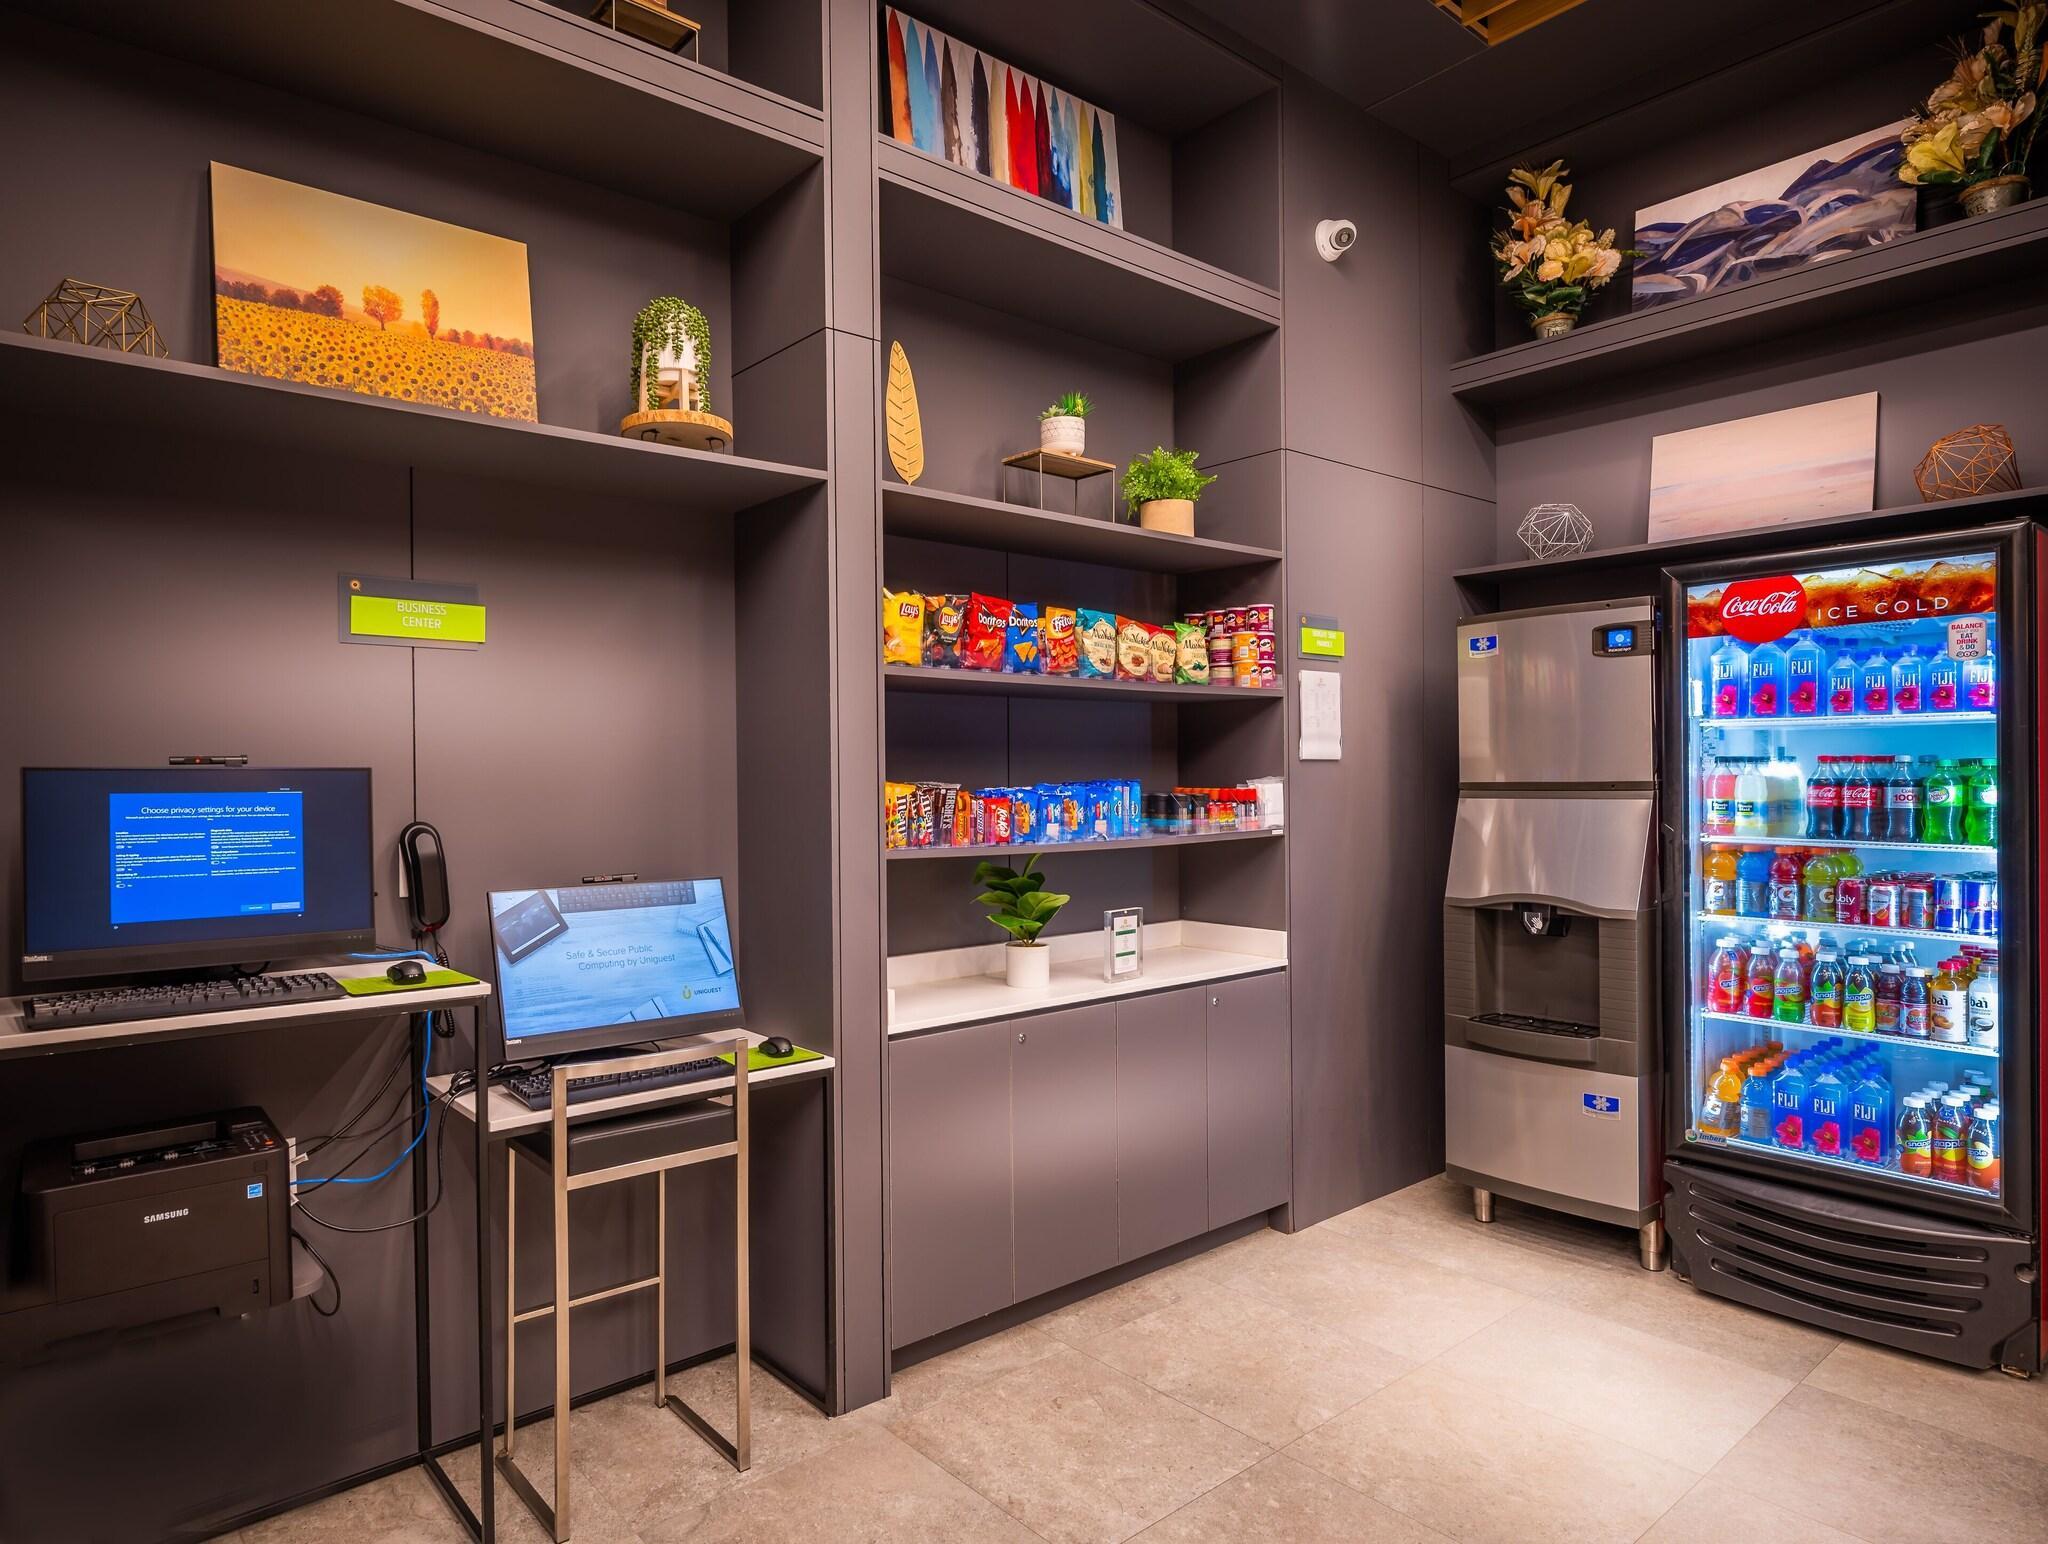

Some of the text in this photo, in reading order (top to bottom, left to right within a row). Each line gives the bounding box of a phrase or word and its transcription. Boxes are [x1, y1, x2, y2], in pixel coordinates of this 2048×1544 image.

[397, 601, 447, 615] BUSINESS
[1723, 590, 1800, 618] Coca-Cola
[1817, 597, 1949, 621] ICE COLD
[402, 616, 441, 629] CENTER
[978, 613, 1006, 628] Doritos
[1009, 616, 1037, 627] Doritos
[1951, 622, 1984, 630] BALANCE
[1753, 663, 1773, 677] FIJI
[1791, 660, 1812, 674] FIJI
[1831, 677, 1851, 690] FIJI
[1865, 675, 1885, 688] FIJI
[1895, 673, 1917, 687] FIJI
[1931, 672, 1953, 686] FIJI
[170, 807, 196, 815] privacy
[198, 806, 224, 814] settings
[566, 945, 653, 960] Safe & Secure Public
[578, 954, 676, 971] Computing by Uniguest
[694, 987, 721, 995] UNIGUEST
[1777, 1092, 1798, 1108] FIJI
[1814, 1098, 1835, 1114] FIJI
[1854, 1103, 1876, 1121] FIJI
[144, 1208, 189, 1224] SAMSUNG
